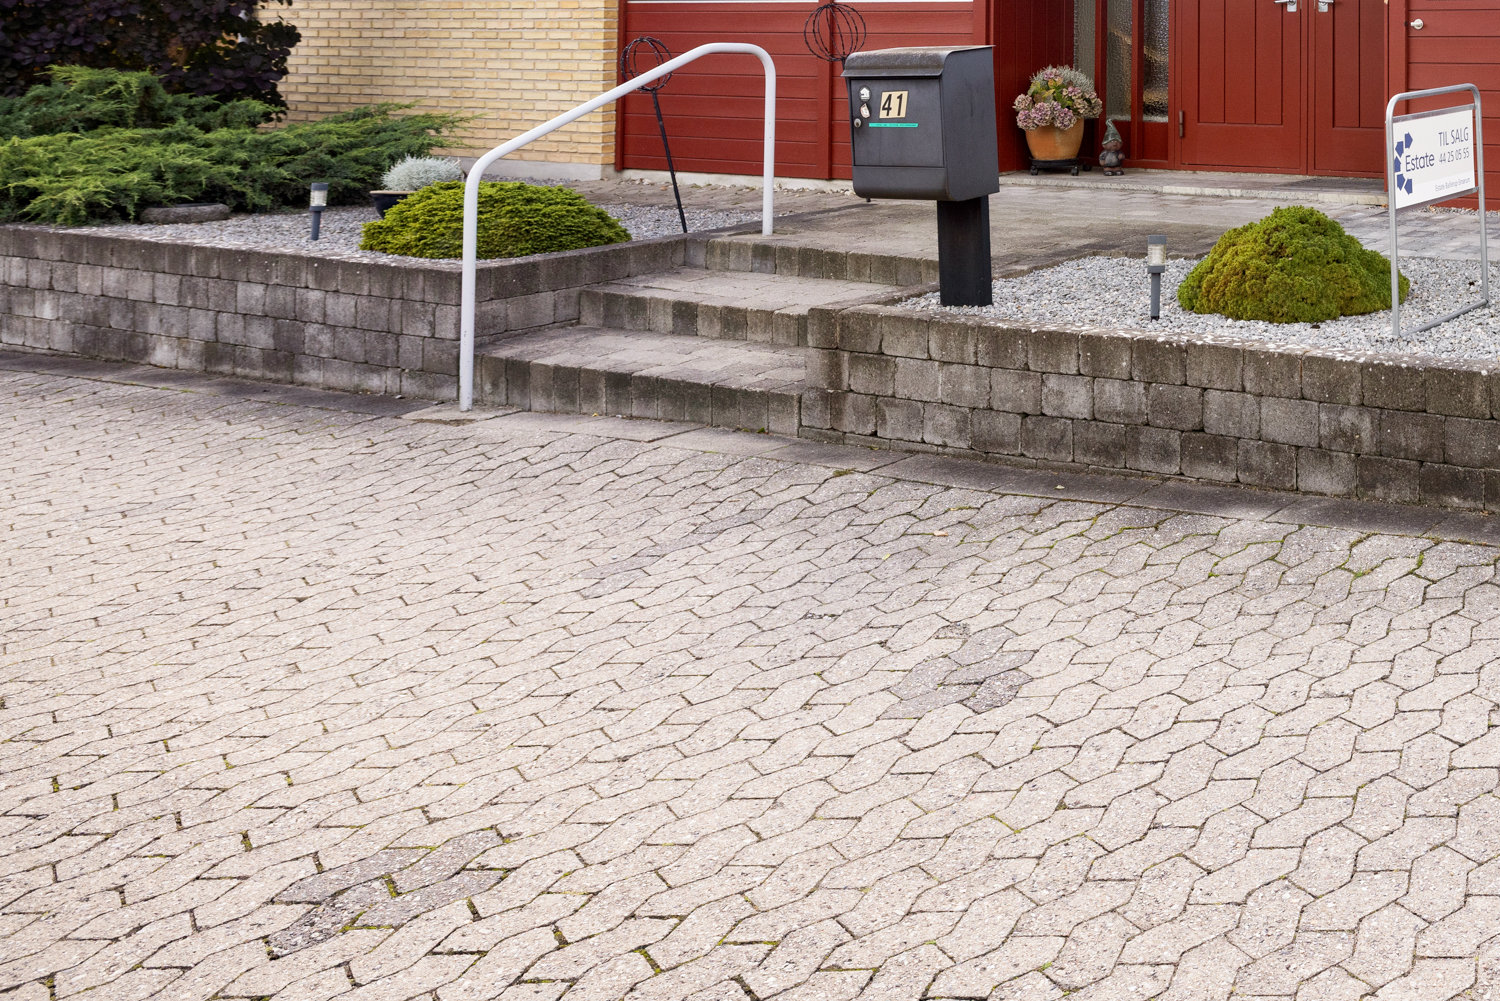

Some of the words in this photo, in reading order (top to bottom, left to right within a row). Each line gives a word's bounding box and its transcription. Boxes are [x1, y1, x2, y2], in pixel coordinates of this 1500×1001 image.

[882, 93, 903, 117] 41
[1438, 131, 1449, 147] TIL
[1451, 126, 1469, 144] SALG
[1405, 152, 1435, 172] Estate
[1439, 152, 1447, 164] 44
[1447, 150, 1454, 163] 25
[1463, 147, 1470, 159] 55
